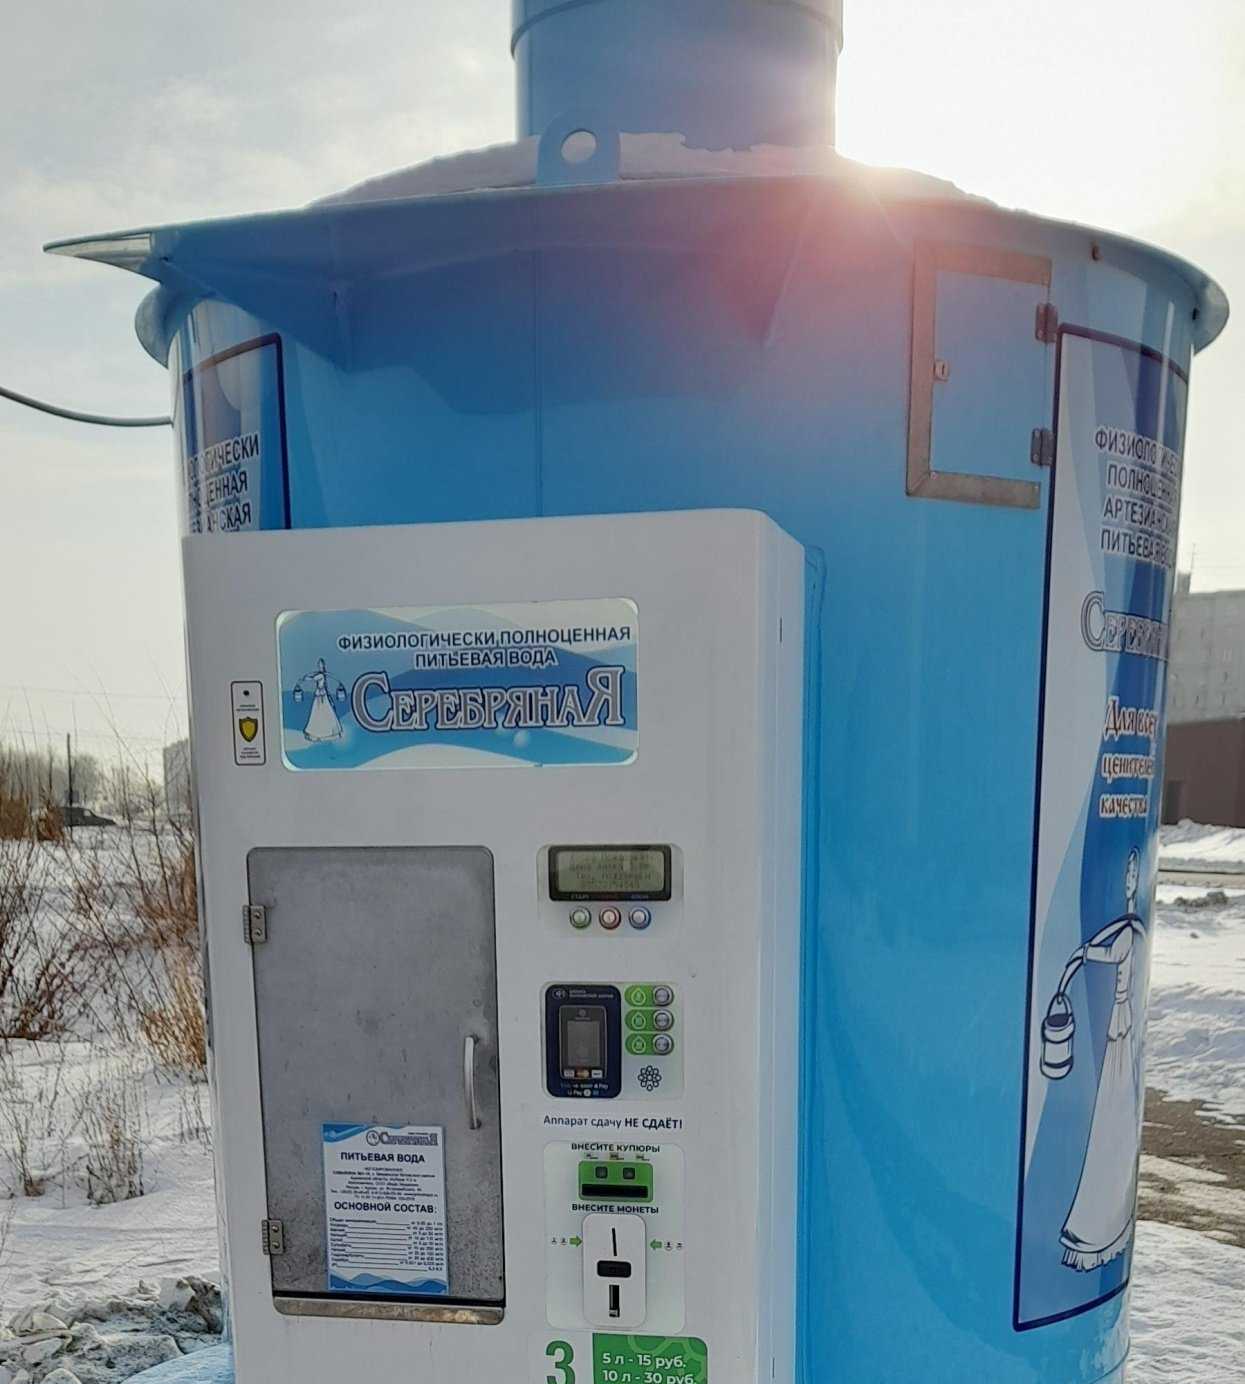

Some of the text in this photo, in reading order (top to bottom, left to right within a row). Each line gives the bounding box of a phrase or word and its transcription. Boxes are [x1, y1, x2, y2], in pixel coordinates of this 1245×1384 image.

[337, 626, 631, 650] ФИЗИОЛОГИЧЕСКИ ПОЛНОЦЕННАЯ
[415, 649, 557, 668] ПИТЬЕВАЯ ВОДА
[543, 1115, 683, 1130] Аппарат сдачу НЕ СДАЁТ!
[571, 1142, 660, 1153] ВНЕСИТЕ КУПЮРЫ
[340, 1151, 425, 1164] ПИТЬЕВАЯ ВОДА
[334, 1201, 438, 1214] ОСНОВНОЙ СОСТАВ:
[571, 1203, 659, 1214] ВНЕСИТЕ МОНЕТЫ
[602, 1352, 611, 1364] 5
[614, 1355, 625, 1365] л
[637, 1354, 651, 1366] 15
[655, 1356, 687, 1370] руб.
[602, 1369, 618, 1382] 10
[621, 1372, 631, 1382] л
[644, 1372, 662, 1384] 30
